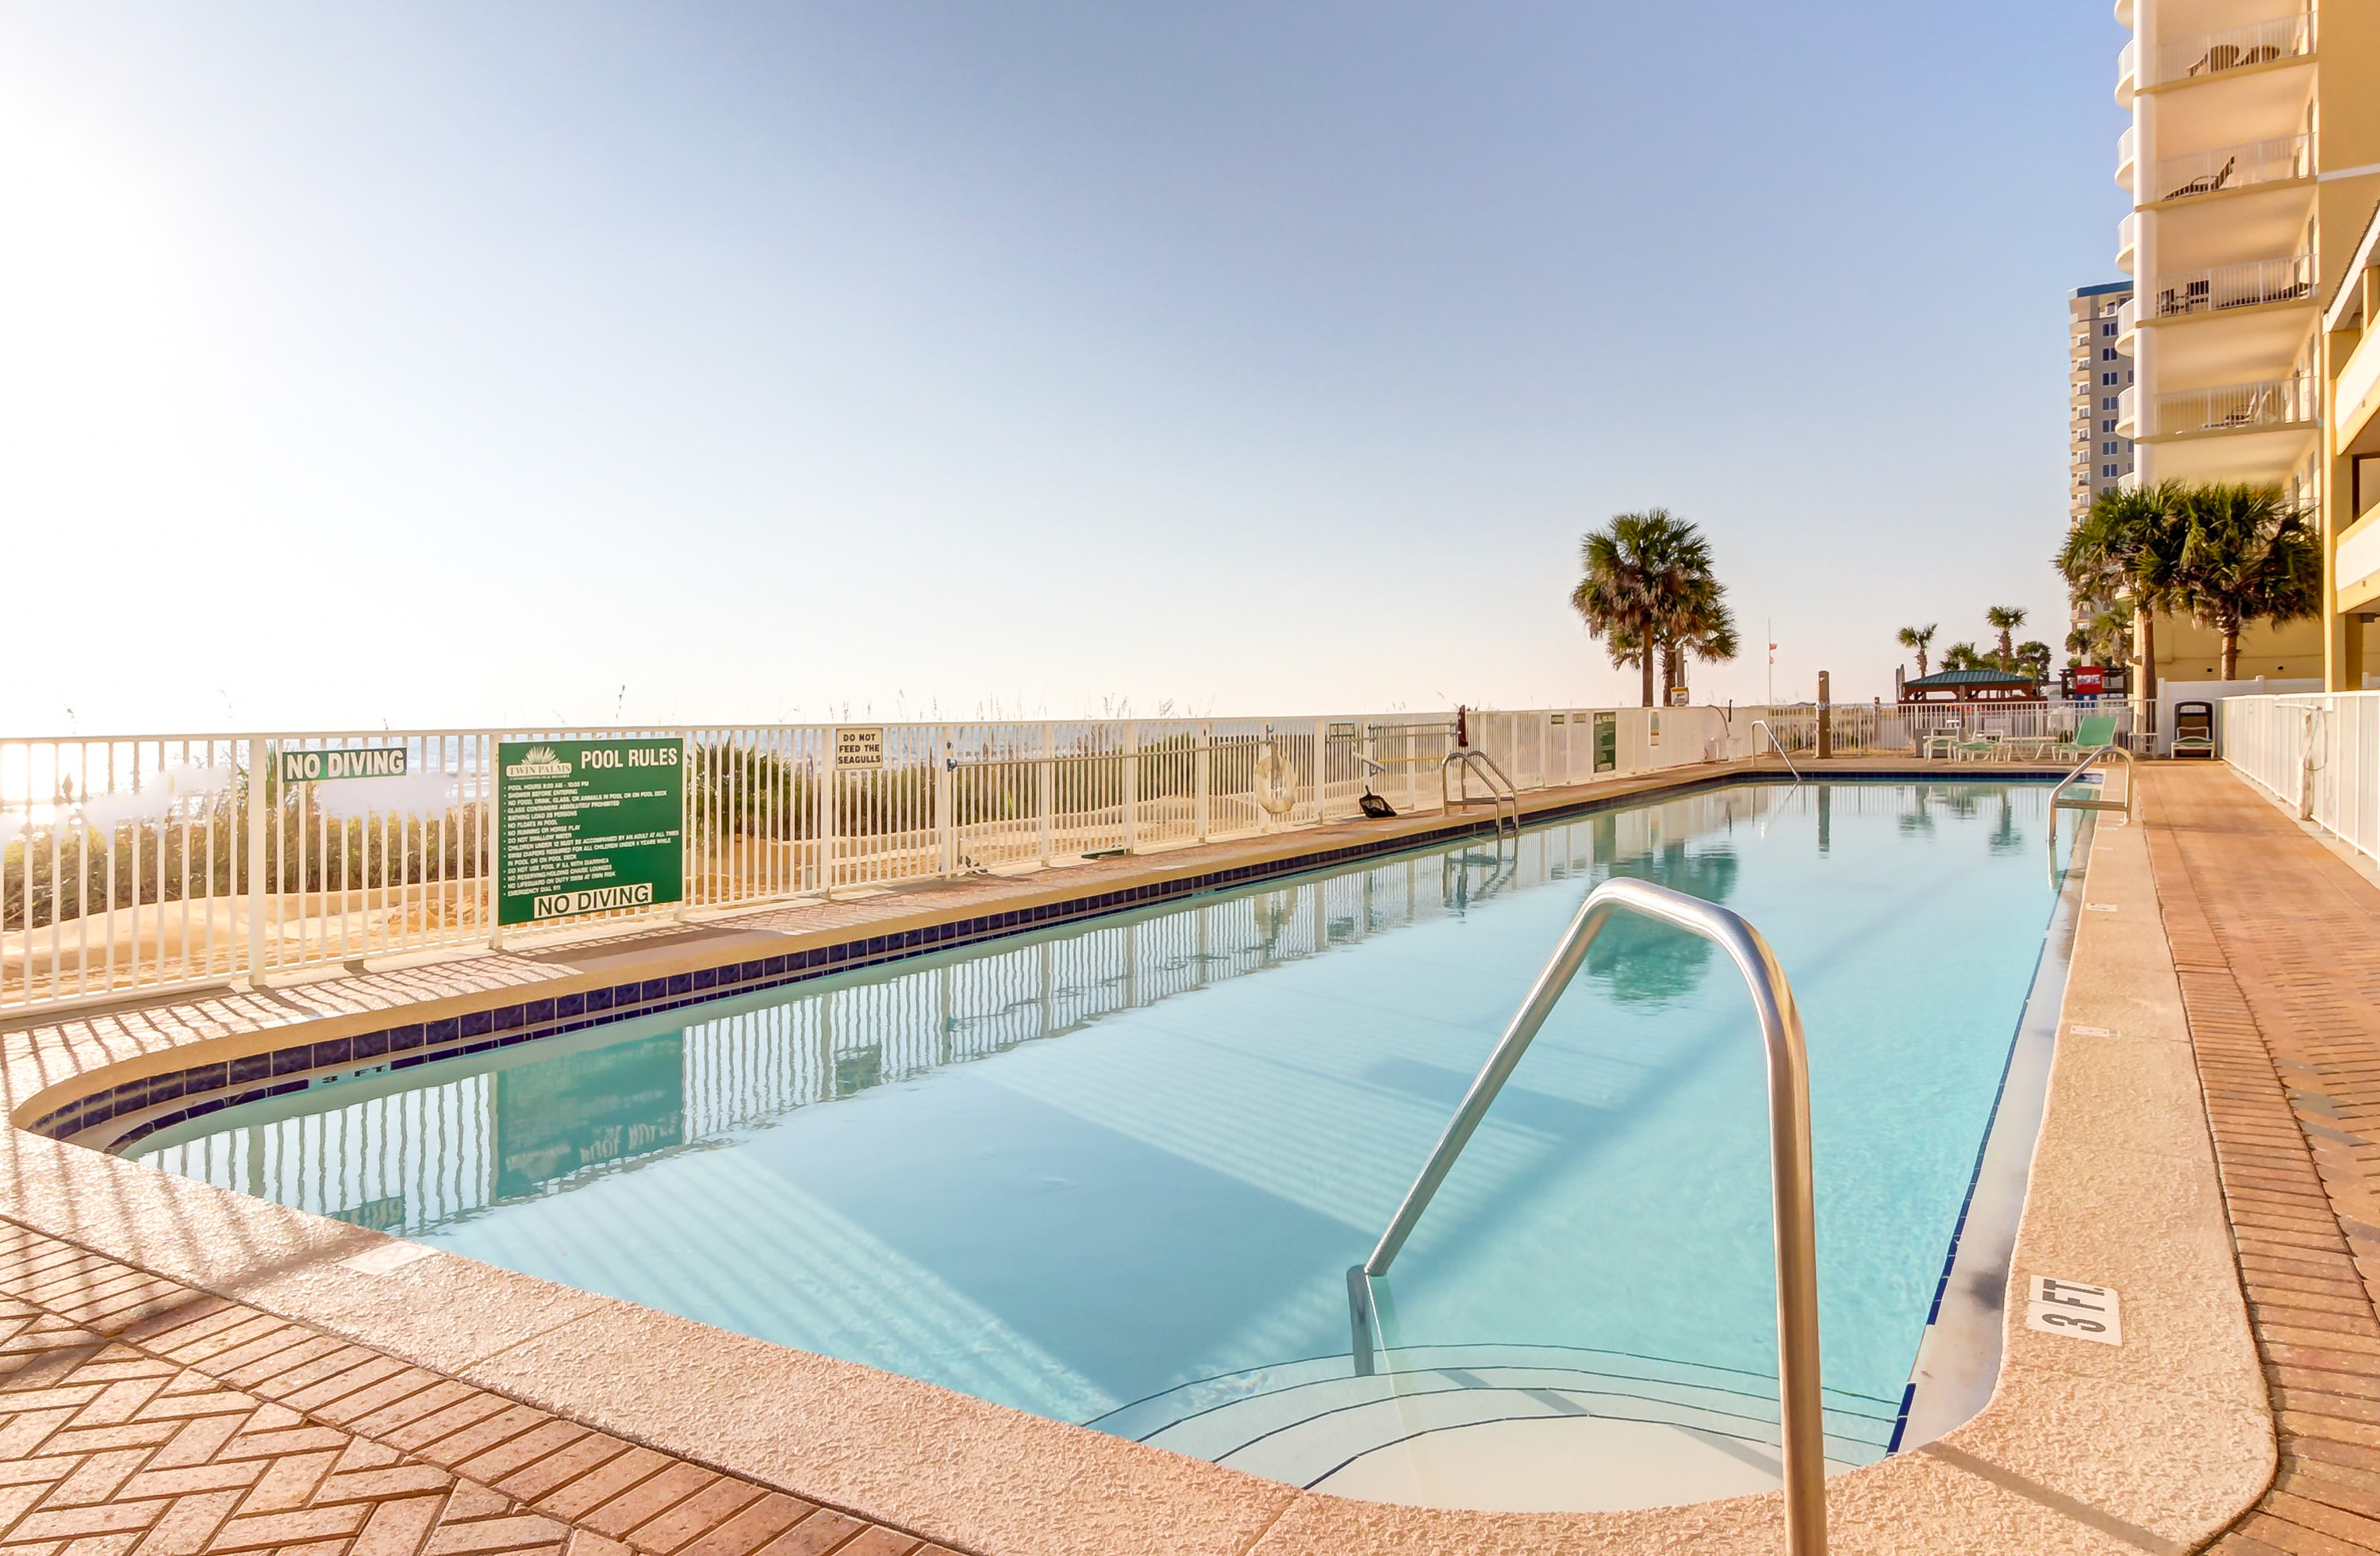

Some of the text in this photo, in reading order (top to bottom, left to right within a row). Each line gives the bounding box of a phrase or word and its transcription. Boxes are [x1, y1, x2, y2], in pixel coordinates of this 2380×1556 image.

[286, 750, 404, 779] NO DIVING
[581, 747, 678, 770] POOL RULES
[838, 755, 881, 764] SEAGULLS
[509, 763, 570, 775] TWIN PALMS
[538, 886, 649, 916] NO DIVING
[322, 1065, 387, 1084] 3 FT
[2041, 1313, 2106, 1333] 3
